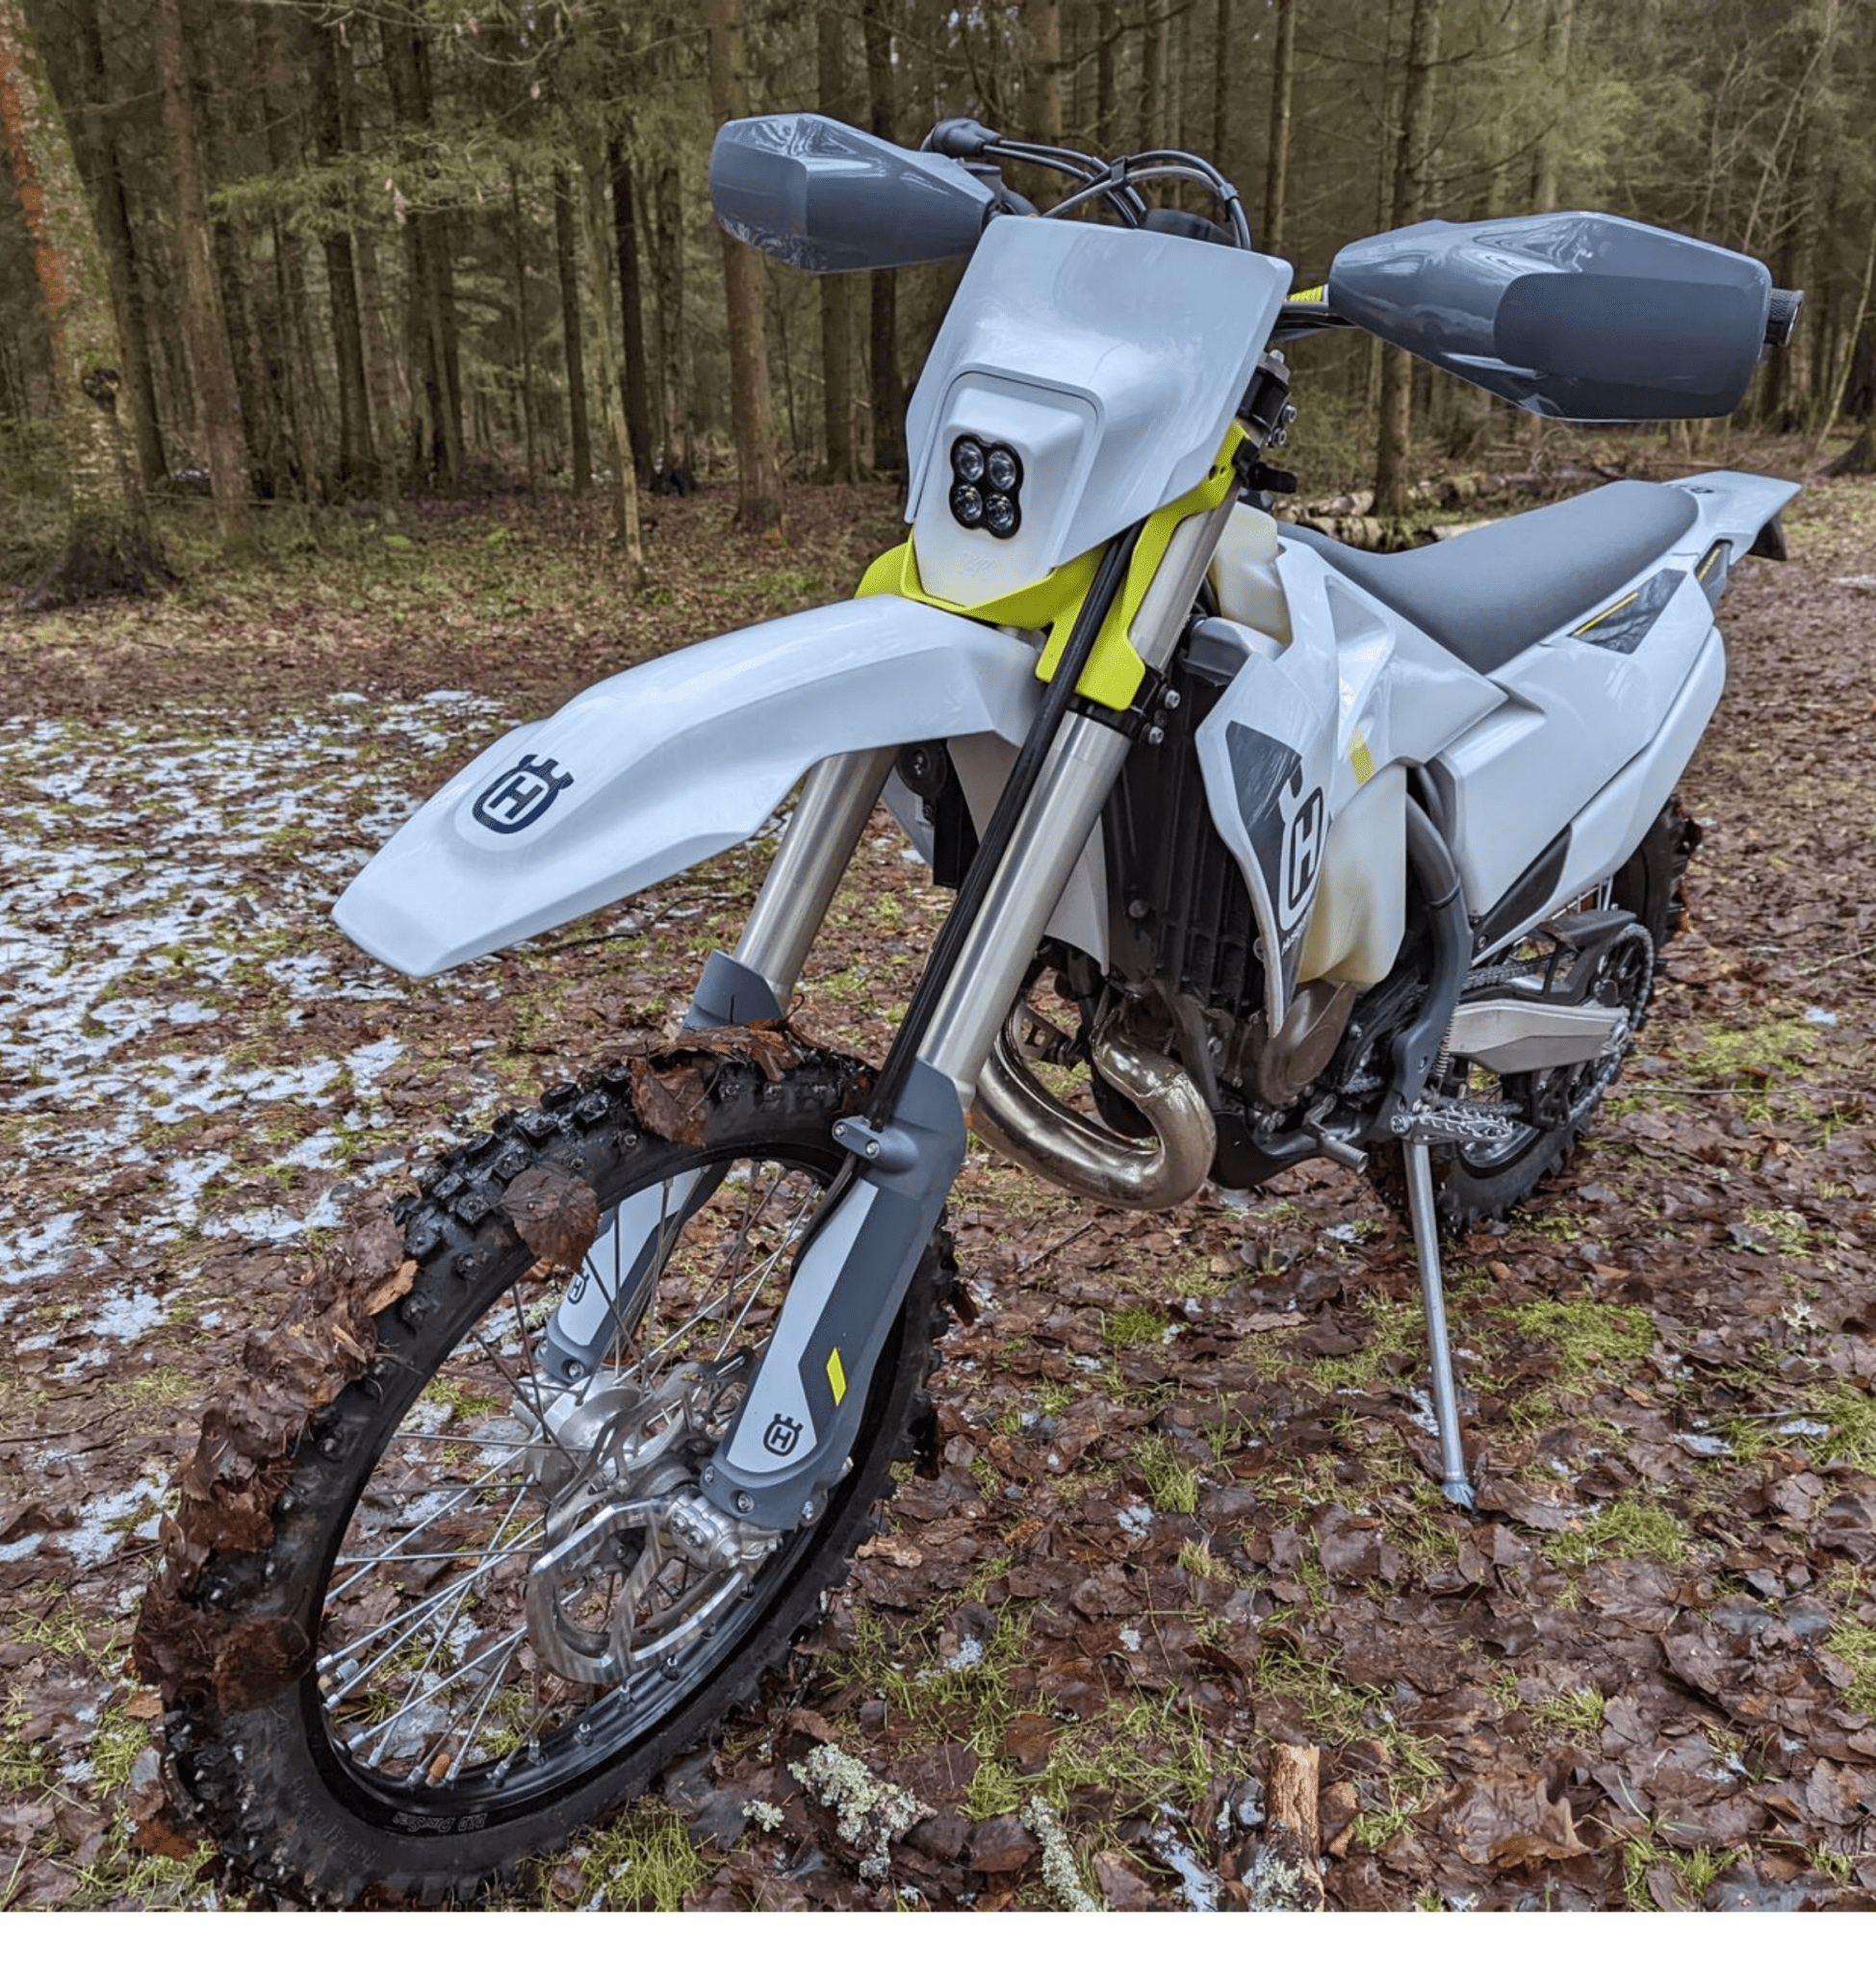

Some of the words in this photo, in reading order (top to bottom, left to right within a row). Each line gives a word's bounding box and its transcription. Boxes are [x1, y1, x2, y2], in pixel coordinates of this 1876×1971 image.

[488, 775, 544, 821] H
[1291, 795, 1321, 902] H
[770, 1425, 792, 1449] H
